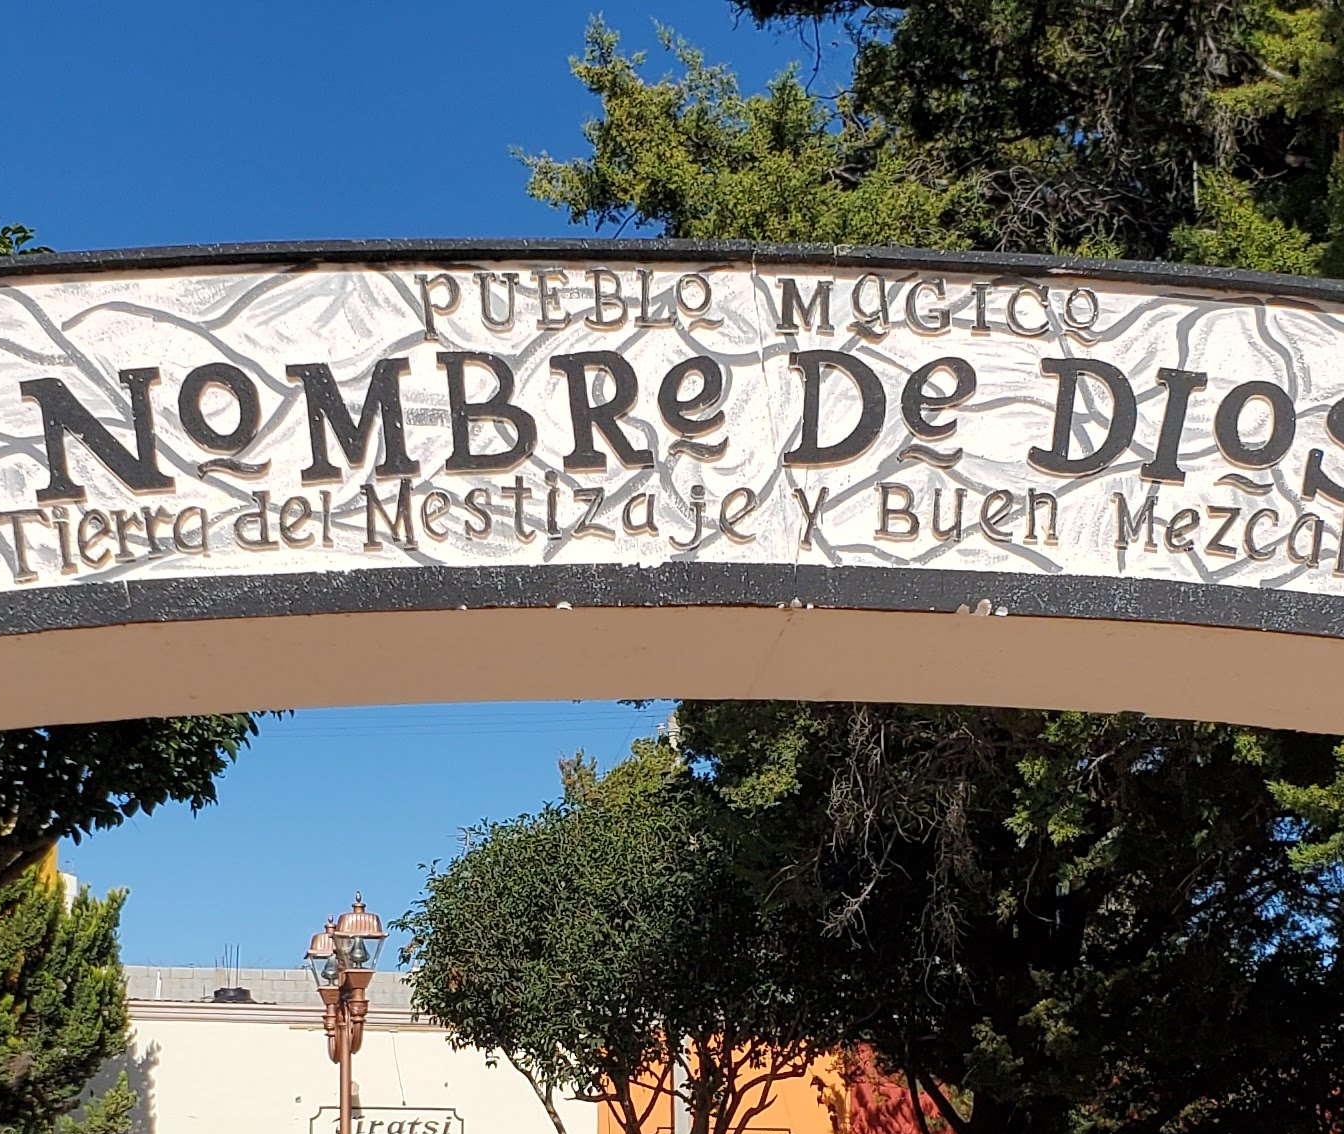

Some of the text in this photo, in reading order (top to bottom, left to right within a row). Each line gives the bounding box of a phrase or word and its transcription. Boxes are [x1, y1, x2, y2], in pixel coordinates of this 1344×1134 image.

[414, 267, 724, 341] PUEBLO
[784, 349, 978, 469] De
[233, 489, 334, 552] del
[362, 470, 758, 553] Mestizaje
[873, 482, 1058, 545] Buen
